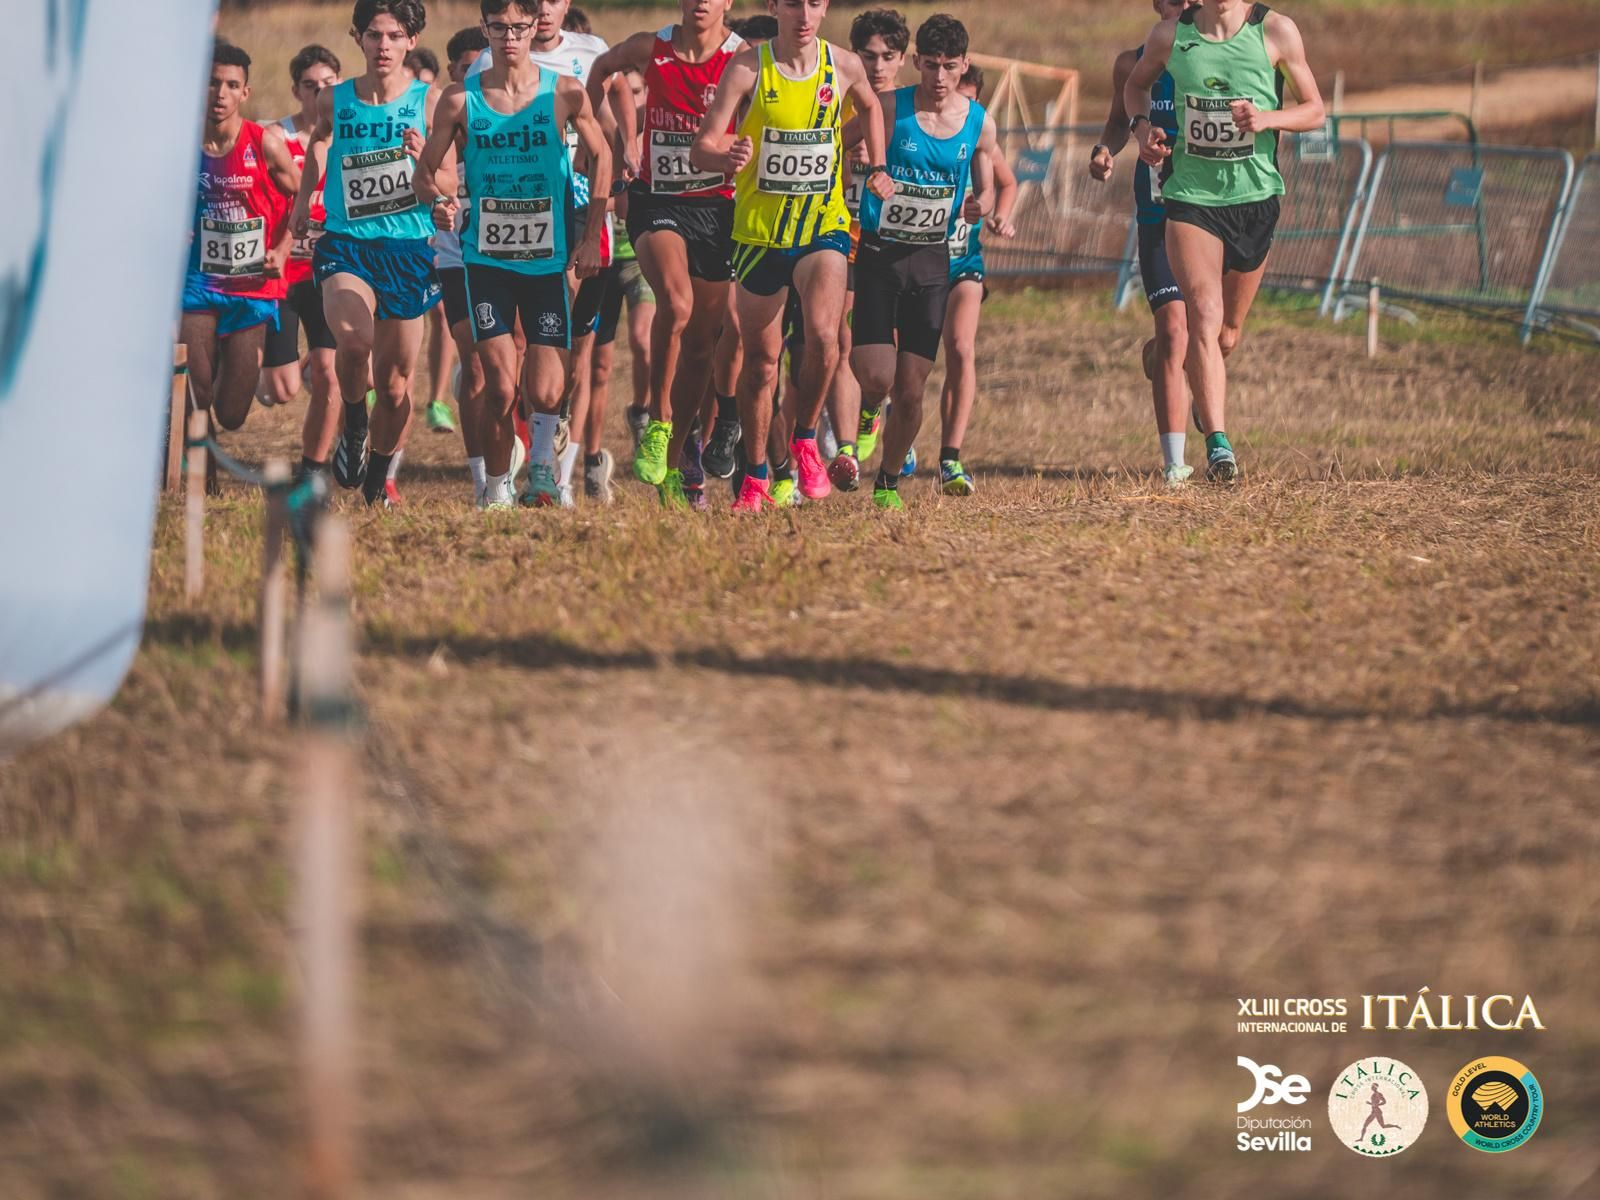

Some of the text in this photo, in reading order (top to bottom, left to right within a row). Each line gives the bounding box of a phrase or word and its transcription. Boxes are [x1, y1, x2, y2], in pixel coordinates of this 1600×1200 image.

[339, 115, 410, 143] nerja
[475, 124, 547, 152] nerja
[488, 155, 538, 164] ATLETISMO
[765, 154, 828, 176] 6058
[348, 171, 411, 200] 8204
[886, 204, 946, 228] 8220
[486, 222, 548, 245] 8217
[206, 239, 259, 261] 8187
